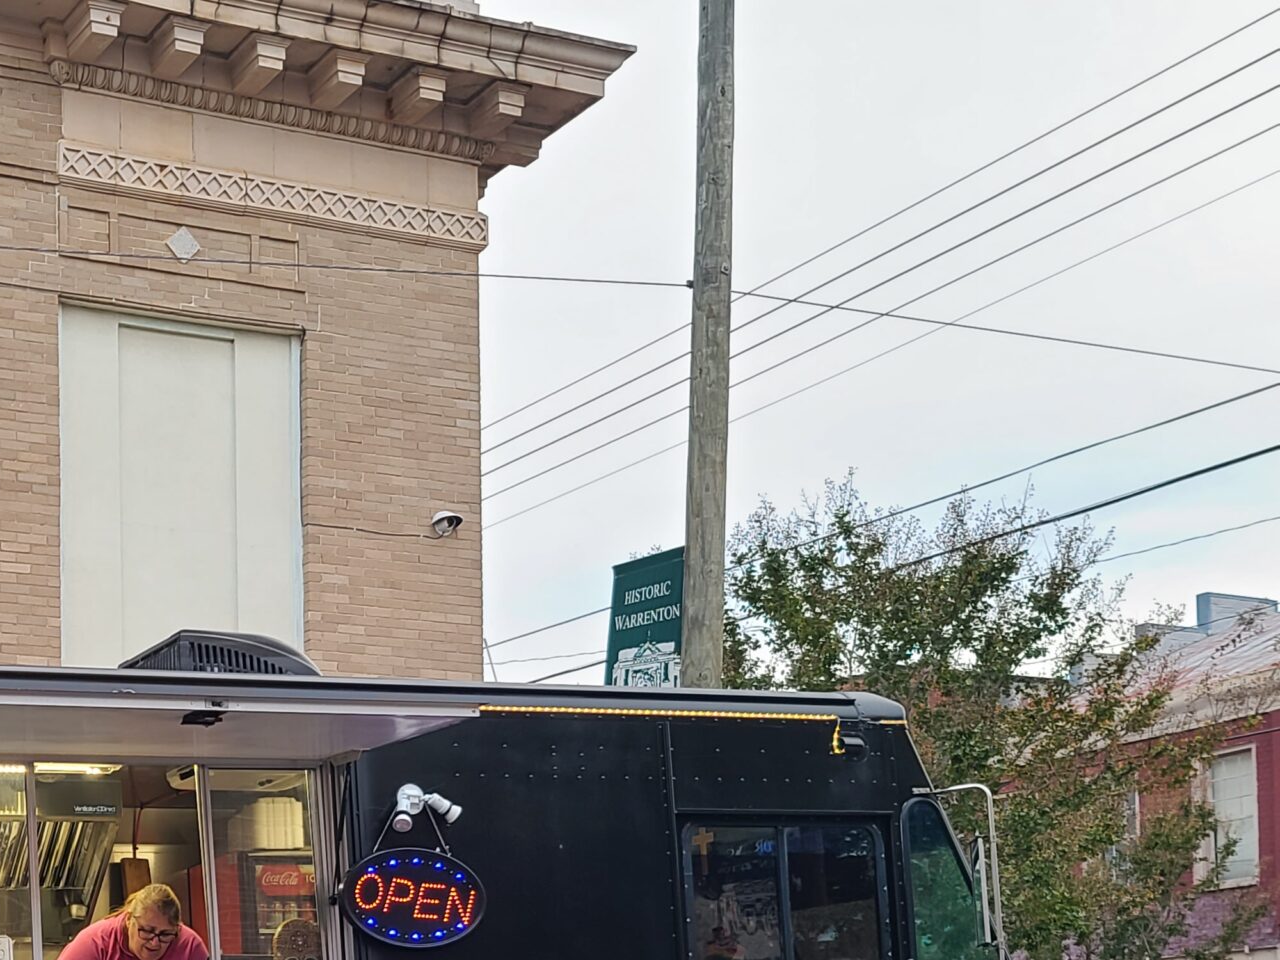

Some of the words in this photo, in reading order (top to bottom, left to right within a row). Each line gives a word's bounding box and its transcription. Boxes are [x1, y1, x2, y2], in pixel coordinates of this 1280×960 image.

[624, 580, 671, 605] HISTORIC
[615, 603, 680, 631] WARRENTON
[354, 872, 477, 926] OPEN
